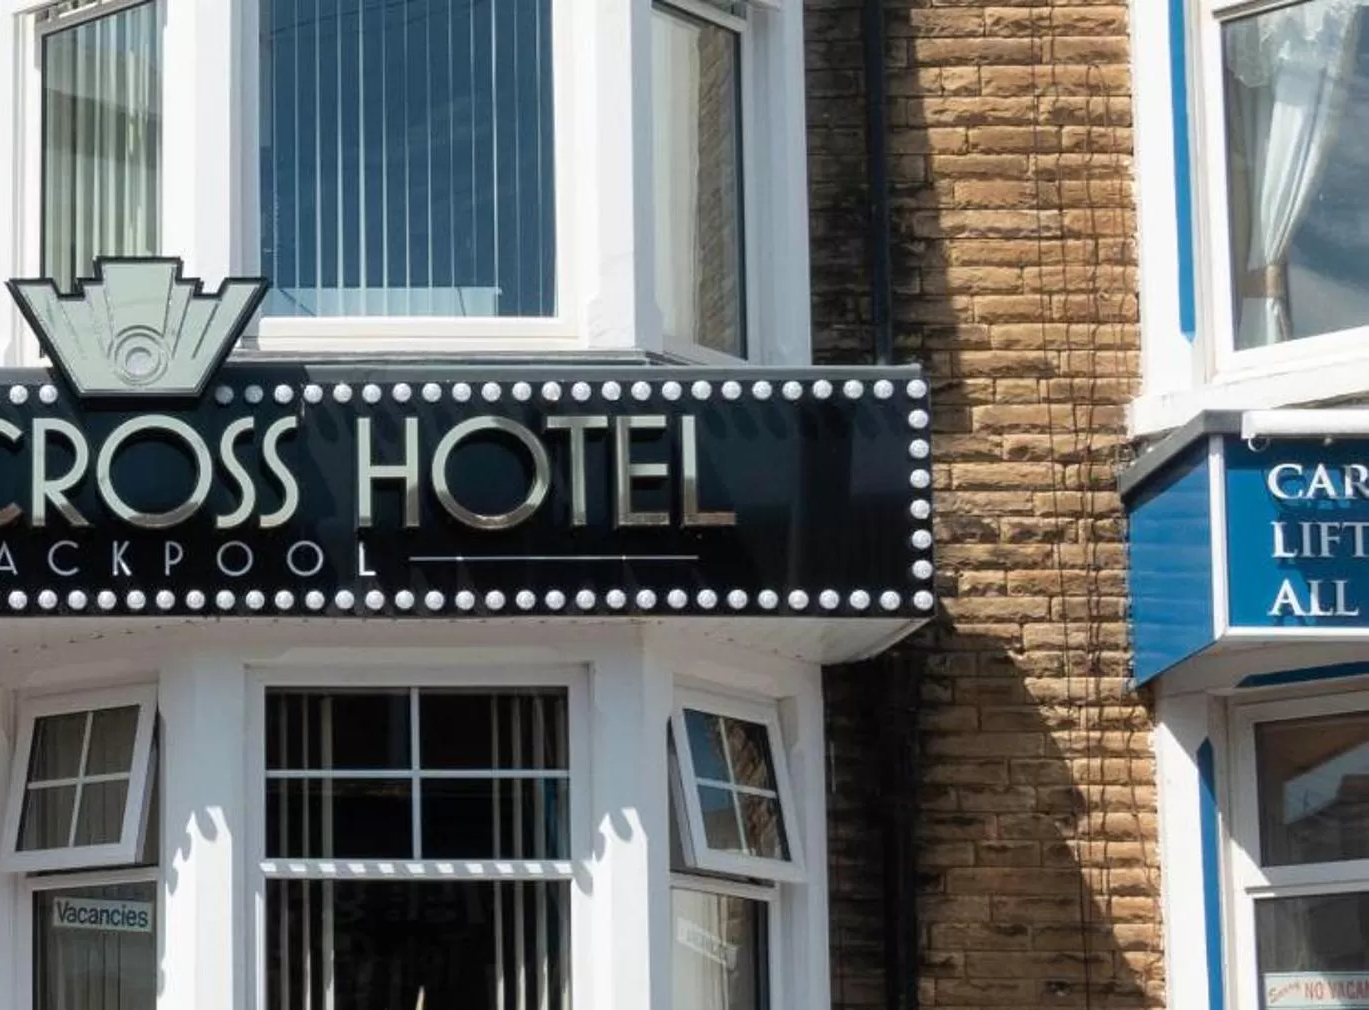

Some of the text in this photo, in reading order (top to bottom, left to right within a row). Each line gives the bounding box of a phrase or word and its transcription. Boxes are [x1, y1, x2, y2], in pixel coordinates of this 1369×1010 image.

[357, 415, 736, 530] HOTEL
[1267, 578, 1359, 617] ALL
[56, 901, 148, 928] Vacancies
[1304, 981, 1324, 1000] NO
